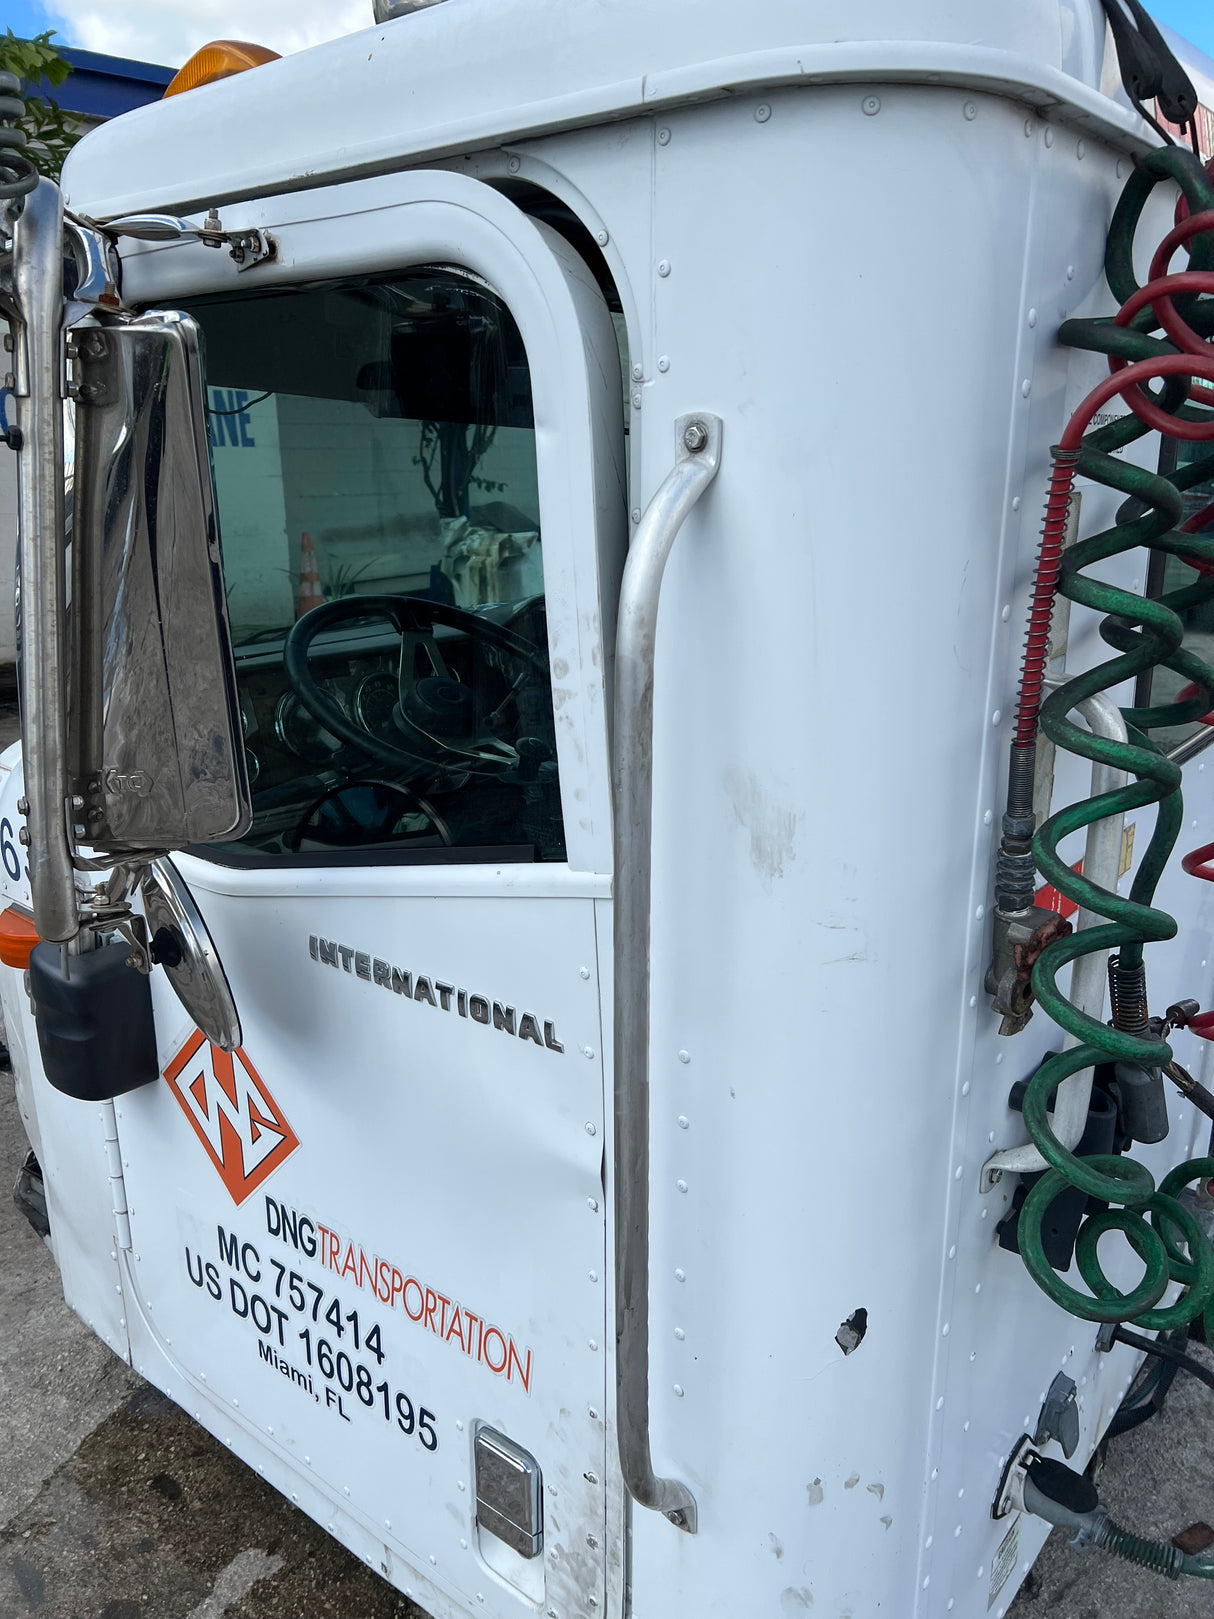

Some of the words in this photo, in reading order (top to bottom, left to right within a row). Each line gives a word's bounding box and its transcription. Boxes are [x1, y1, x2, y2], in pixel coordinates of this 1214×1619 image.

[308, 934, 565, 1054] INTERNATIONAL
[185, 1246, 222, 1301] US
[229, 1277, 290, 1347] DOT
[299, 1328, 438, 1451] 1608195
[217, 1224, 261, 1283] MC
[270, 1258, 385, 1365] 757414
[257, 1338, 320, 1402] Miami,
[325, 1386, 351, 1422] FL
